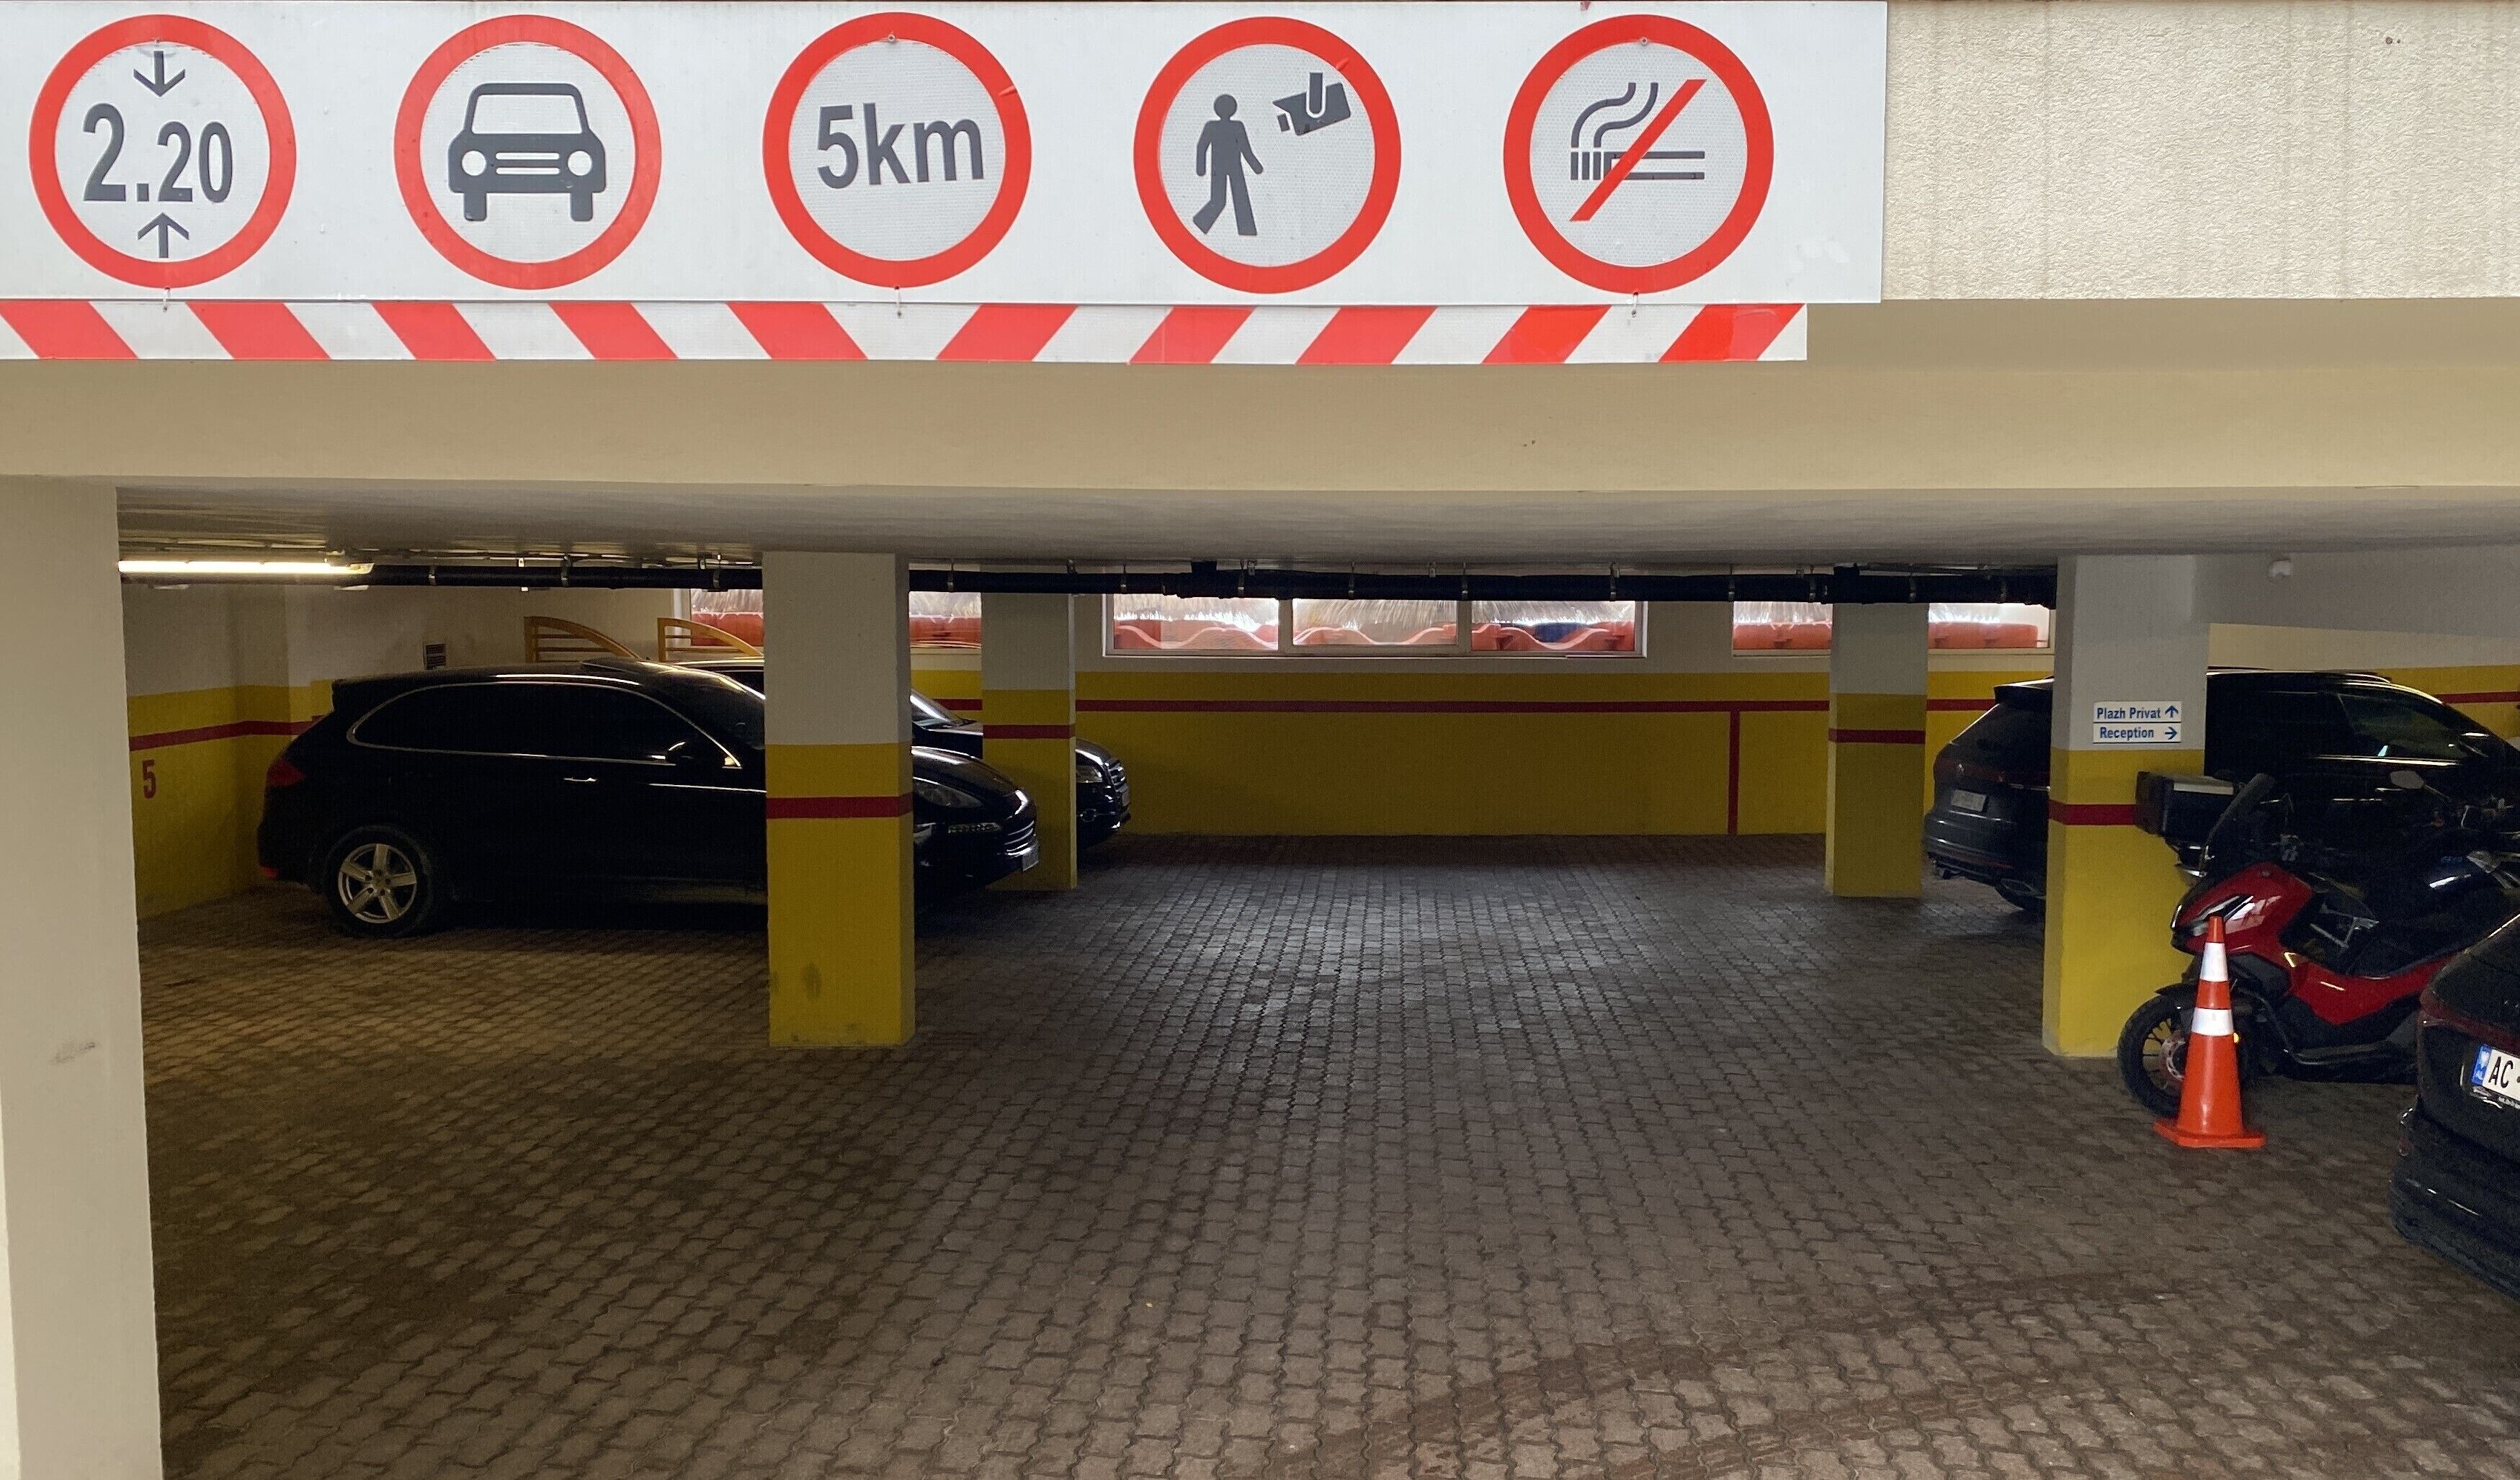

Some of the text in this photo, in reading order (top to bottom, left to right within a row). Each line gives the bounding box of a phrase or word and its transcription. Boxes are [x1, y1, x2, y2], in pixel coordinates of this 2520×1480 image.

[82, 102, 234, 204] 2.20
[816, 102, 985, 190] 5km
[2096, 707, 2161, 719] Plazh Privat
[2099, 727, 2155, 740] Reception
[142, 759, 157, 799] 5
